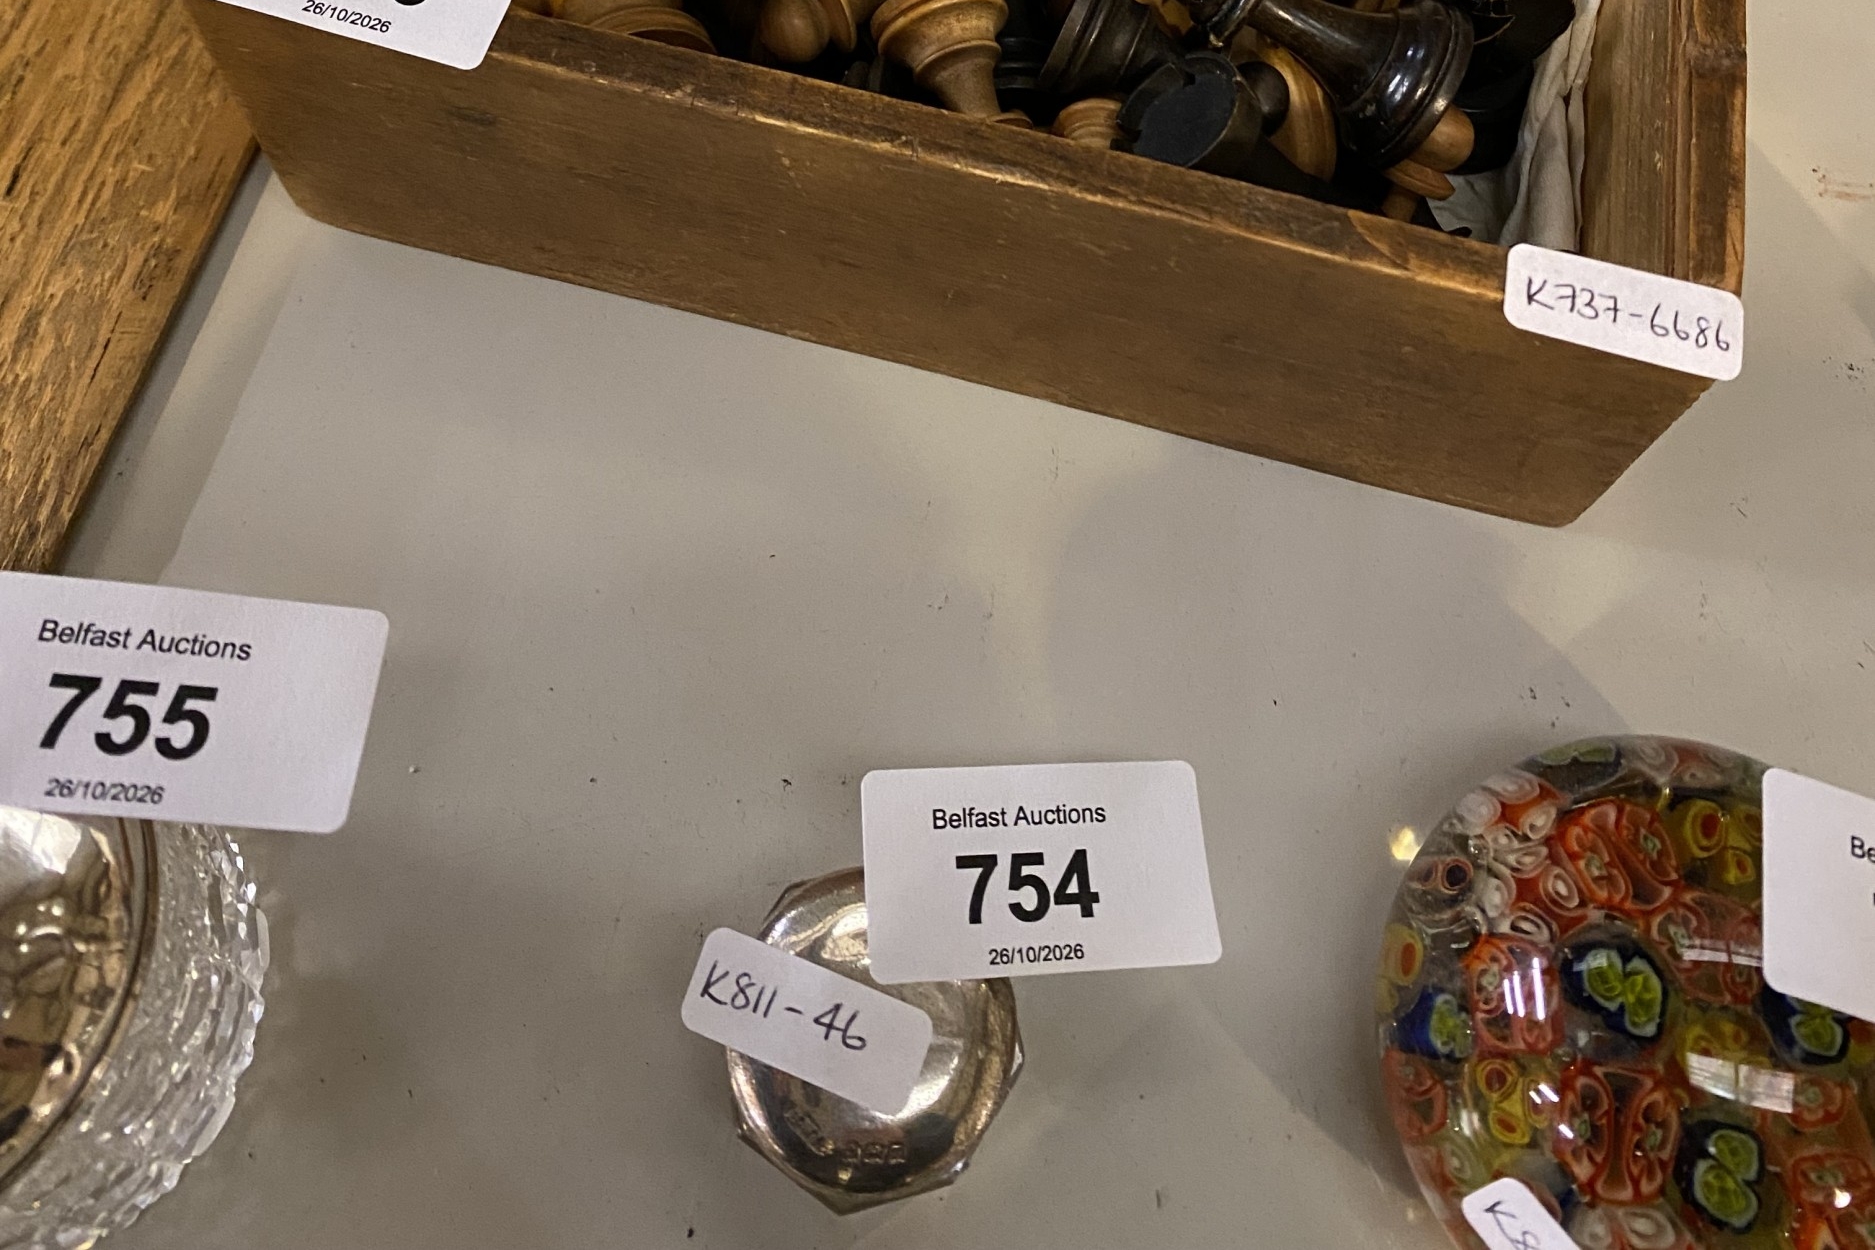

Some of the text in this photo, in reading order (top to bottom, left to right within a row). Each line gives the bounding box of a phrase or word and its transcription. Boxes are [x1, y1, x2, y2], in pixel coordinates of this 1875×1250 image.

[301, 0, 392, 34] 26/10/2026
[1526, 276, 1731, 352] K737-6686
[37, 618, 253, 662] Belfast Auctions
[38, 671, 219, 762] 755
[43, 777, 166, 805] 26/10/2026
[932, 803, 1107, 830] Belfast Auctions
[954, 848, 1101, 925] 754
[988, 942, 1085, 966] 26/10/2026
[699, 959, 867, 1051] K811-46
